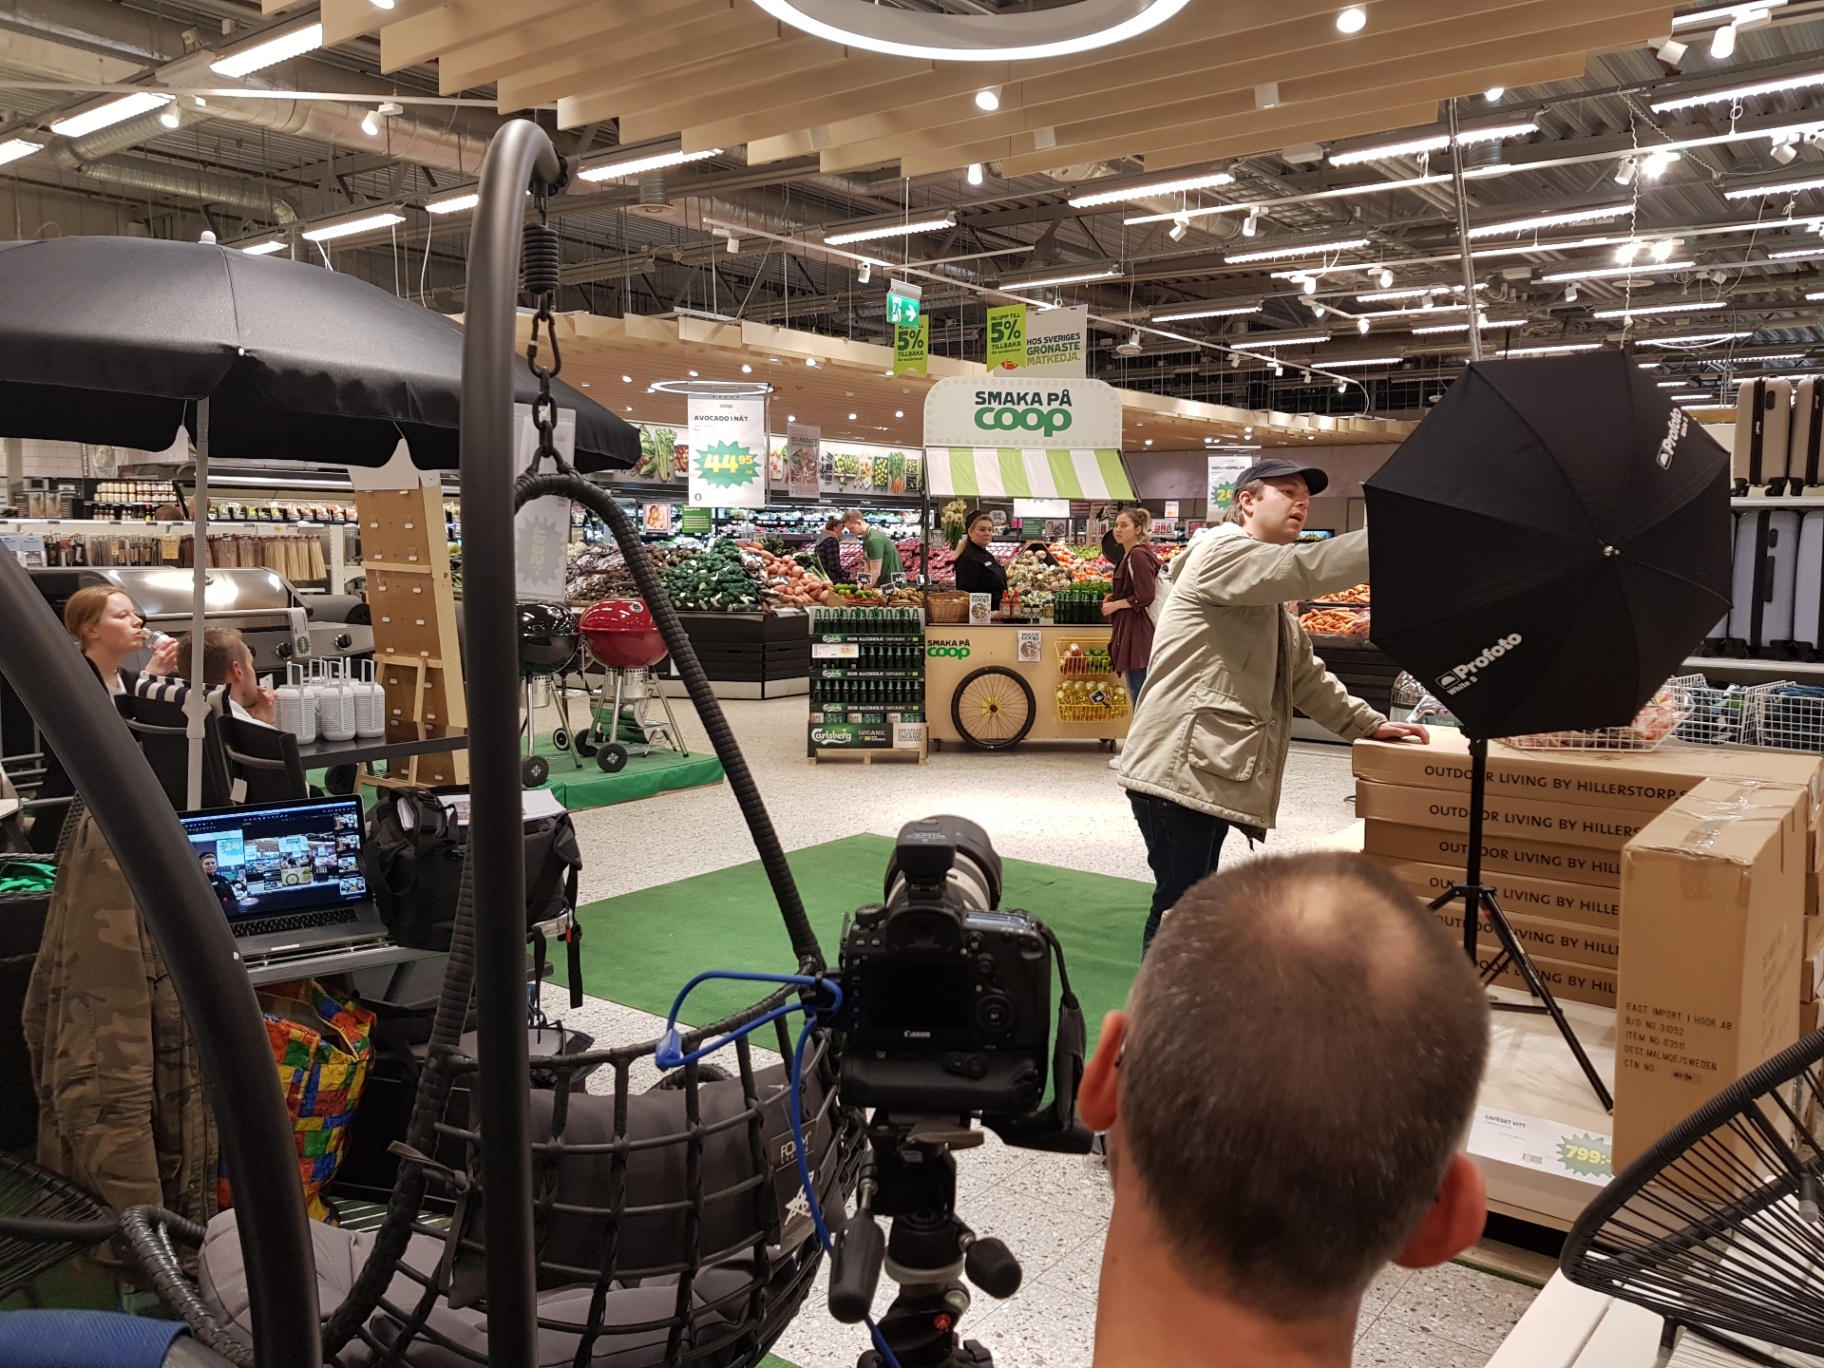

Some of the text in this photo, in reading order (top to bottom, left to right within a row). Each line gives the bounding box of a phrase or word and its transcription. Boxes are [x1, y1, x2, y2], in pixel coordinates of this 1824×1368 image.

[991, 319, 1021, 343] 5%
[898, 330, 924, 351] 5%
[991, 341, 1021, 350] TILLBAKA
[1027, 332, 1080, 346] HOS SVERIGES
[1027, 341, 1080, 356] GRÖNASTE
[1027, 352, 1080, 366] MATKEDJA.
[975, 389, 1072, 407] SMAKA PÅ
[734, 414, 749, 422] NÄT
[974, 407, 1072, 437] coop
[1662, 408, 1682, 456] Profoto
[927, 647, 970, 660] coop
[1452, 633, 1522, 680] Profoto
[1447, 681, 1471, 695] White
[811, 728, 851, 745] Carlsberg
[1425, 765, 1494, 782] OUTDOR
[1500, 773, 1547, 788] LIVING
[1553, 778, 1572, 791] BY
[1429, 804, 1499, 822] OUTDOR
[1505, 813, 1553, 829] LIVING
[1559, 819, 1577, 831] BY
[1439, 841, 1508, 860] OUTOOR
[1514, 851, 1562, 867] LIVING
[1568, 857, 1587, 871] BY
[1503, 889, 1550, 905] LIVING
[1557, 897, 1575, 908] BY
[1561, 936, 1579, 948] BY
[1568, 976, 1586, 987] BY
[1626, 1002, 1648, 1013] EAST
[1653, 1008, 1682, 1020] IMPORT
[1721, 1021, 1732, 1030] AB
[904, 1030, 931, 1038] Canon
[1660, 1024, 1684, 1037] 31052
[1626, 1031, 1645, 1041] ITEM
[1664, 1039, 1685, 1050] 63511
[1624, 1045, 1644, 1055] DEST
[1624, 1059, 1639, 1069] CTN
[1485, 1114, 1512, 1125] CAFÉSET
